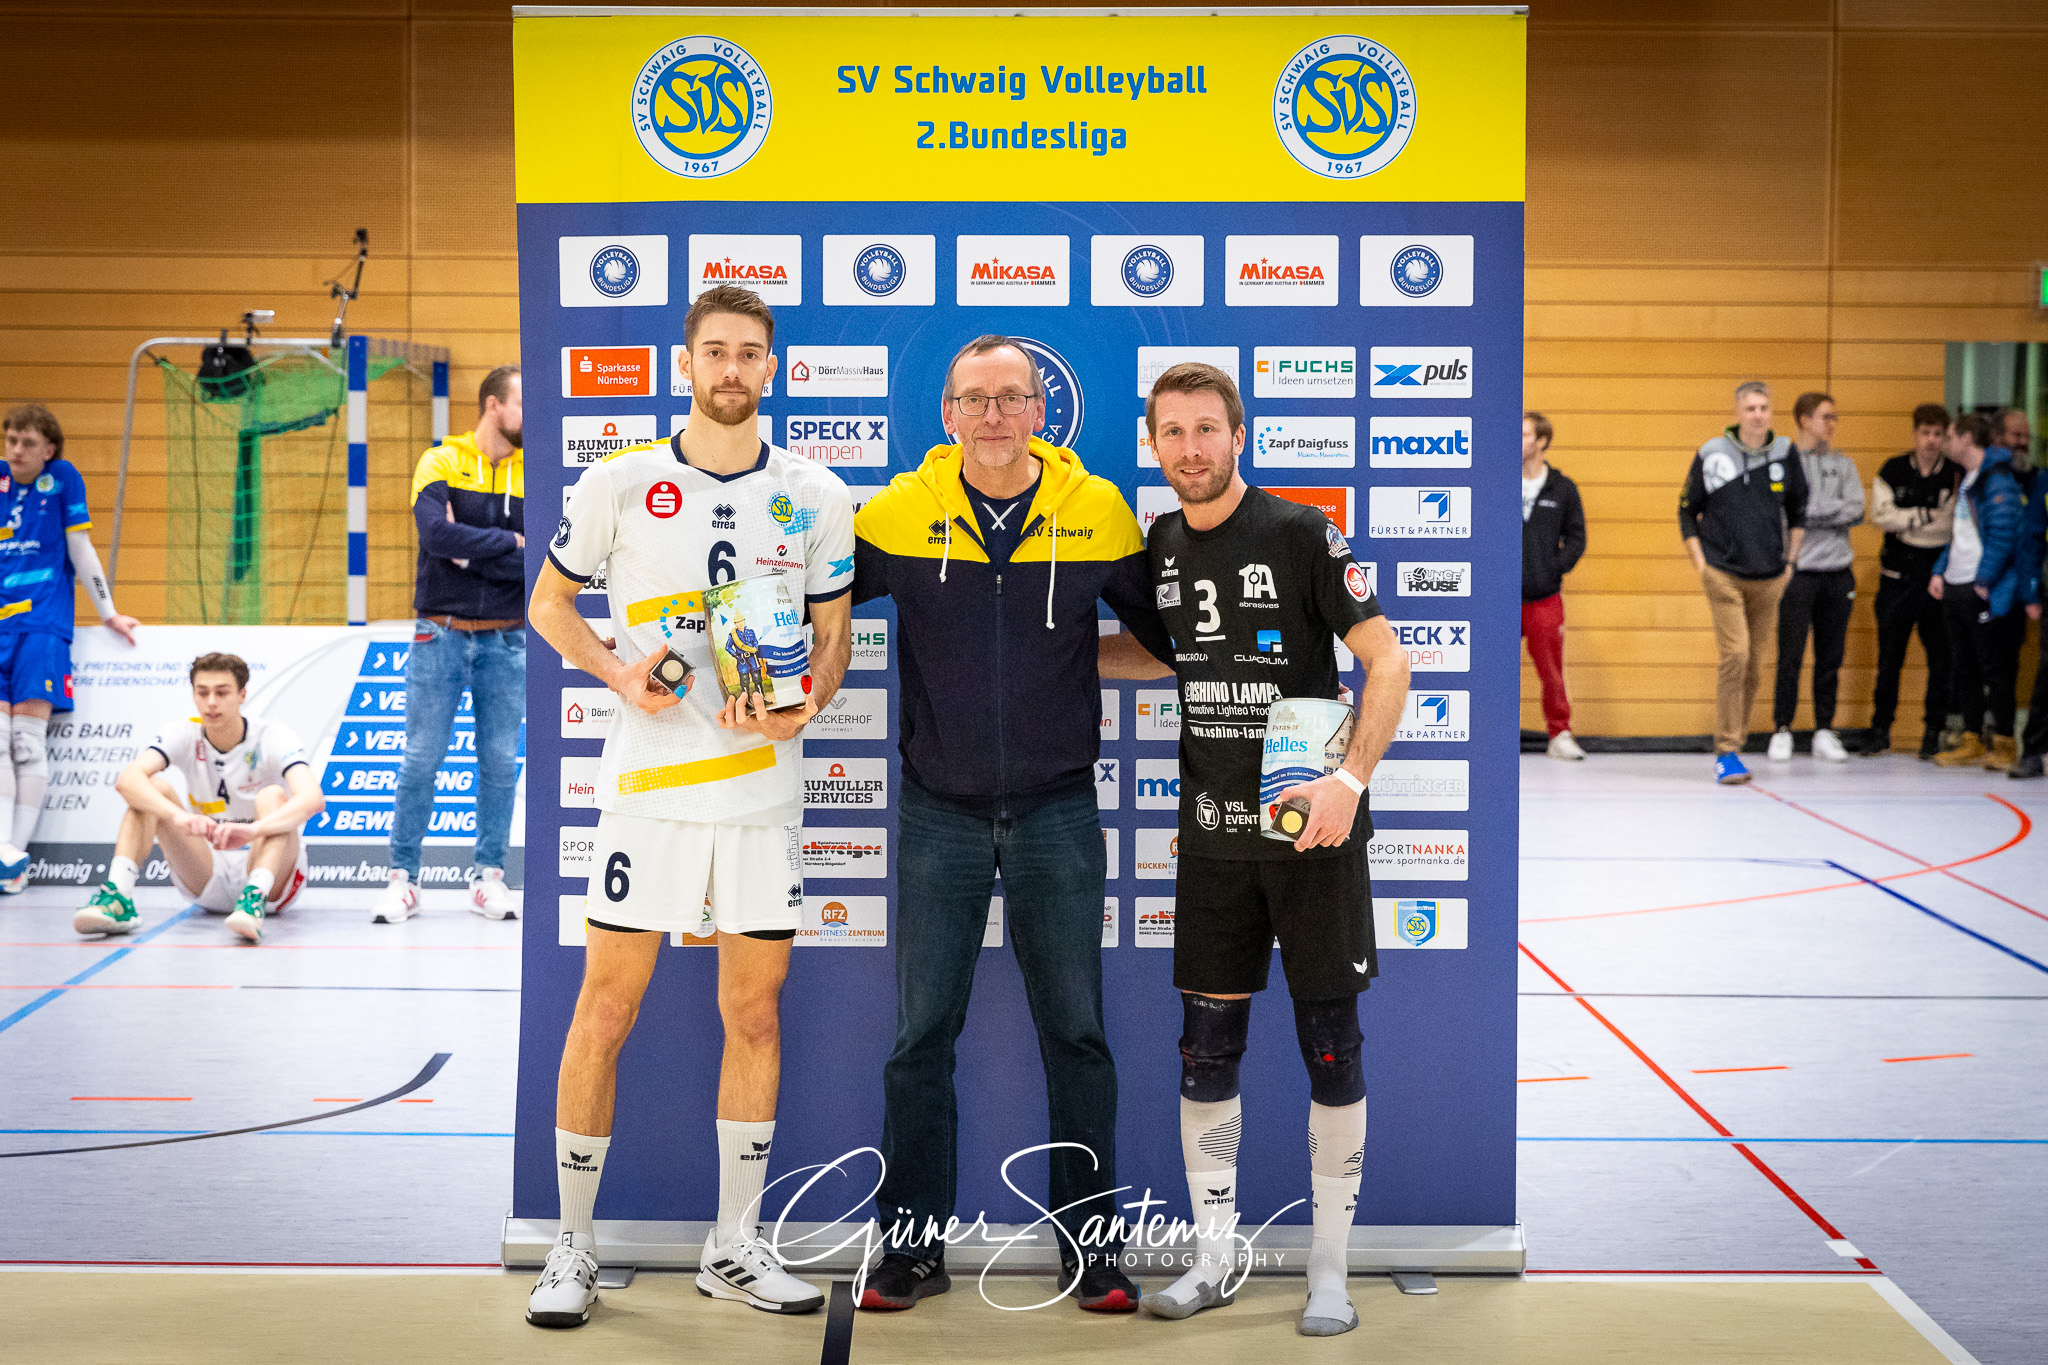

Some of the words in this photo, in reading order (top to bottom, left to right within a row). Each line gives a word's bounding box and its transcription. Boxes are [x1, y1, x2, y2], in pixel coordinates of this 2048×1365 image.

[638, 43, 688, 107] SCHWAIG
[1279, 43, 1330, 105] SCHWAIG
[712, 42, 766, 131] VOLLEYBALL
[837, 65, 880, 94] SV
[894, 65, 1026, 101] Schwaig
[1040, 65, 1208, 101] Volleyball
[1356, 42, 1411, 130] VOLLEYBALL
[639, 112, 652, 132] SV
[1279, 112, 1293, 132] SV
[916, 121, 1127, 157] 2.Bundesliga
[684, 161, 719, 174] 1967
[1327, 161, 1363, 175] 1967
[595, 251, 634, 269] VOLLEYBALL
[860, 250, 899, 268] VOLLEYBALL
[1127, 251, 1167, 269] VOLLEYBALL
[1396, 250, 1436, 268] VOLLEYBALL
[702, 258, 788, 279] MIKASA
[970, 258, 1056, 279] MIKASA
[1239, 258, 1325, 280] MIKASA
[596, 275, 634, 292] BUNDESLIGA
[861, 275, 899, 292] BUNDESLIGA
[1128, 275, 1167, 292] BUNDESLIGA
[1397, 276, 1436, 292] BUNDESLIGA
[597, 363, 641, 374] Sparkasse
[818, 365, 884, 375] DörrMassivHaus
[1278, 360, 1354, 373] FUCHS
[1423, 359, 1468, 386] puls
[597, 375, 638, 386] Nürnberg
[672, 383, 693, 393] FÜR
[1278, 376, 1305, 385] Ideen
[1307, 376, 1354, 385] umsetzen
[789, 421, 862, 441] SPECK
[1268, 438, 1296, 451] Zapf
[1297, 438, 1349, 451] Daigfuss
[1372, 429, 1469, 456] maxit
[1047, 526, 1094, 540] Schwaig
[1371, 525, 1406, 535] FÜRST
[1408, 526, 1415, 535] &
[1418, 526, 1468, 535] PARTNER
[707, 540, 737, 587] 6
[756, 557, 804, 570] Heinzelmann
[1408, 581, 1459, 592] HOUSE
[1193, 579, 1221, 634] 3
[1238, 601, 1280, 609] abrasives
[675, 615, 706, 631] Zap
[773, 609, 800, 627] Hell
[1393, 626, 1443, 646] ECK
[851, 648, 886, 658] setzen
[1231, 682, 1284, 704] LAMPS
[1187, 704, 1215, 715] tomotive
[1216, 704, 1249, 717] Lighted
[1249, 705, 1271, 716] Prod
[809, 714, 873, 725] ROCKERHOF
[1159, 719, 1181, 728] Idee
[78, 722, 134, 739] BAUR
[1189, 725, 1266, 739] www.oshino-lam
[1406, 730, 1414, 739] &
[1416, 730, 1467, 739] PARTNER
[1265, 736, 1308, 754] Helles
[804, 780, 883, 792] AUMÜLLER
[803, 792, 873, 804] SERVICES
[1224, 801, 1249, 812] VSL
[1225, 814, 1259, 825] EVENT
[803, 842, 882, 858] chweiger
[1369, 844, 1465, 855] SPORTNANKA
[1369, 856, 1466, 867] www.sportnanka.de
[26, 857, 93, 884] chwaig
[145, 859, 171, 881] 09
[604, 851, 632, 903] 6
[823, 909, 846, 920] RFZ
[740, 1151, 770, 1162] erim
[561, 1160, 599, 1173] erima
[1203, 1194, 1235, 1206] erima
